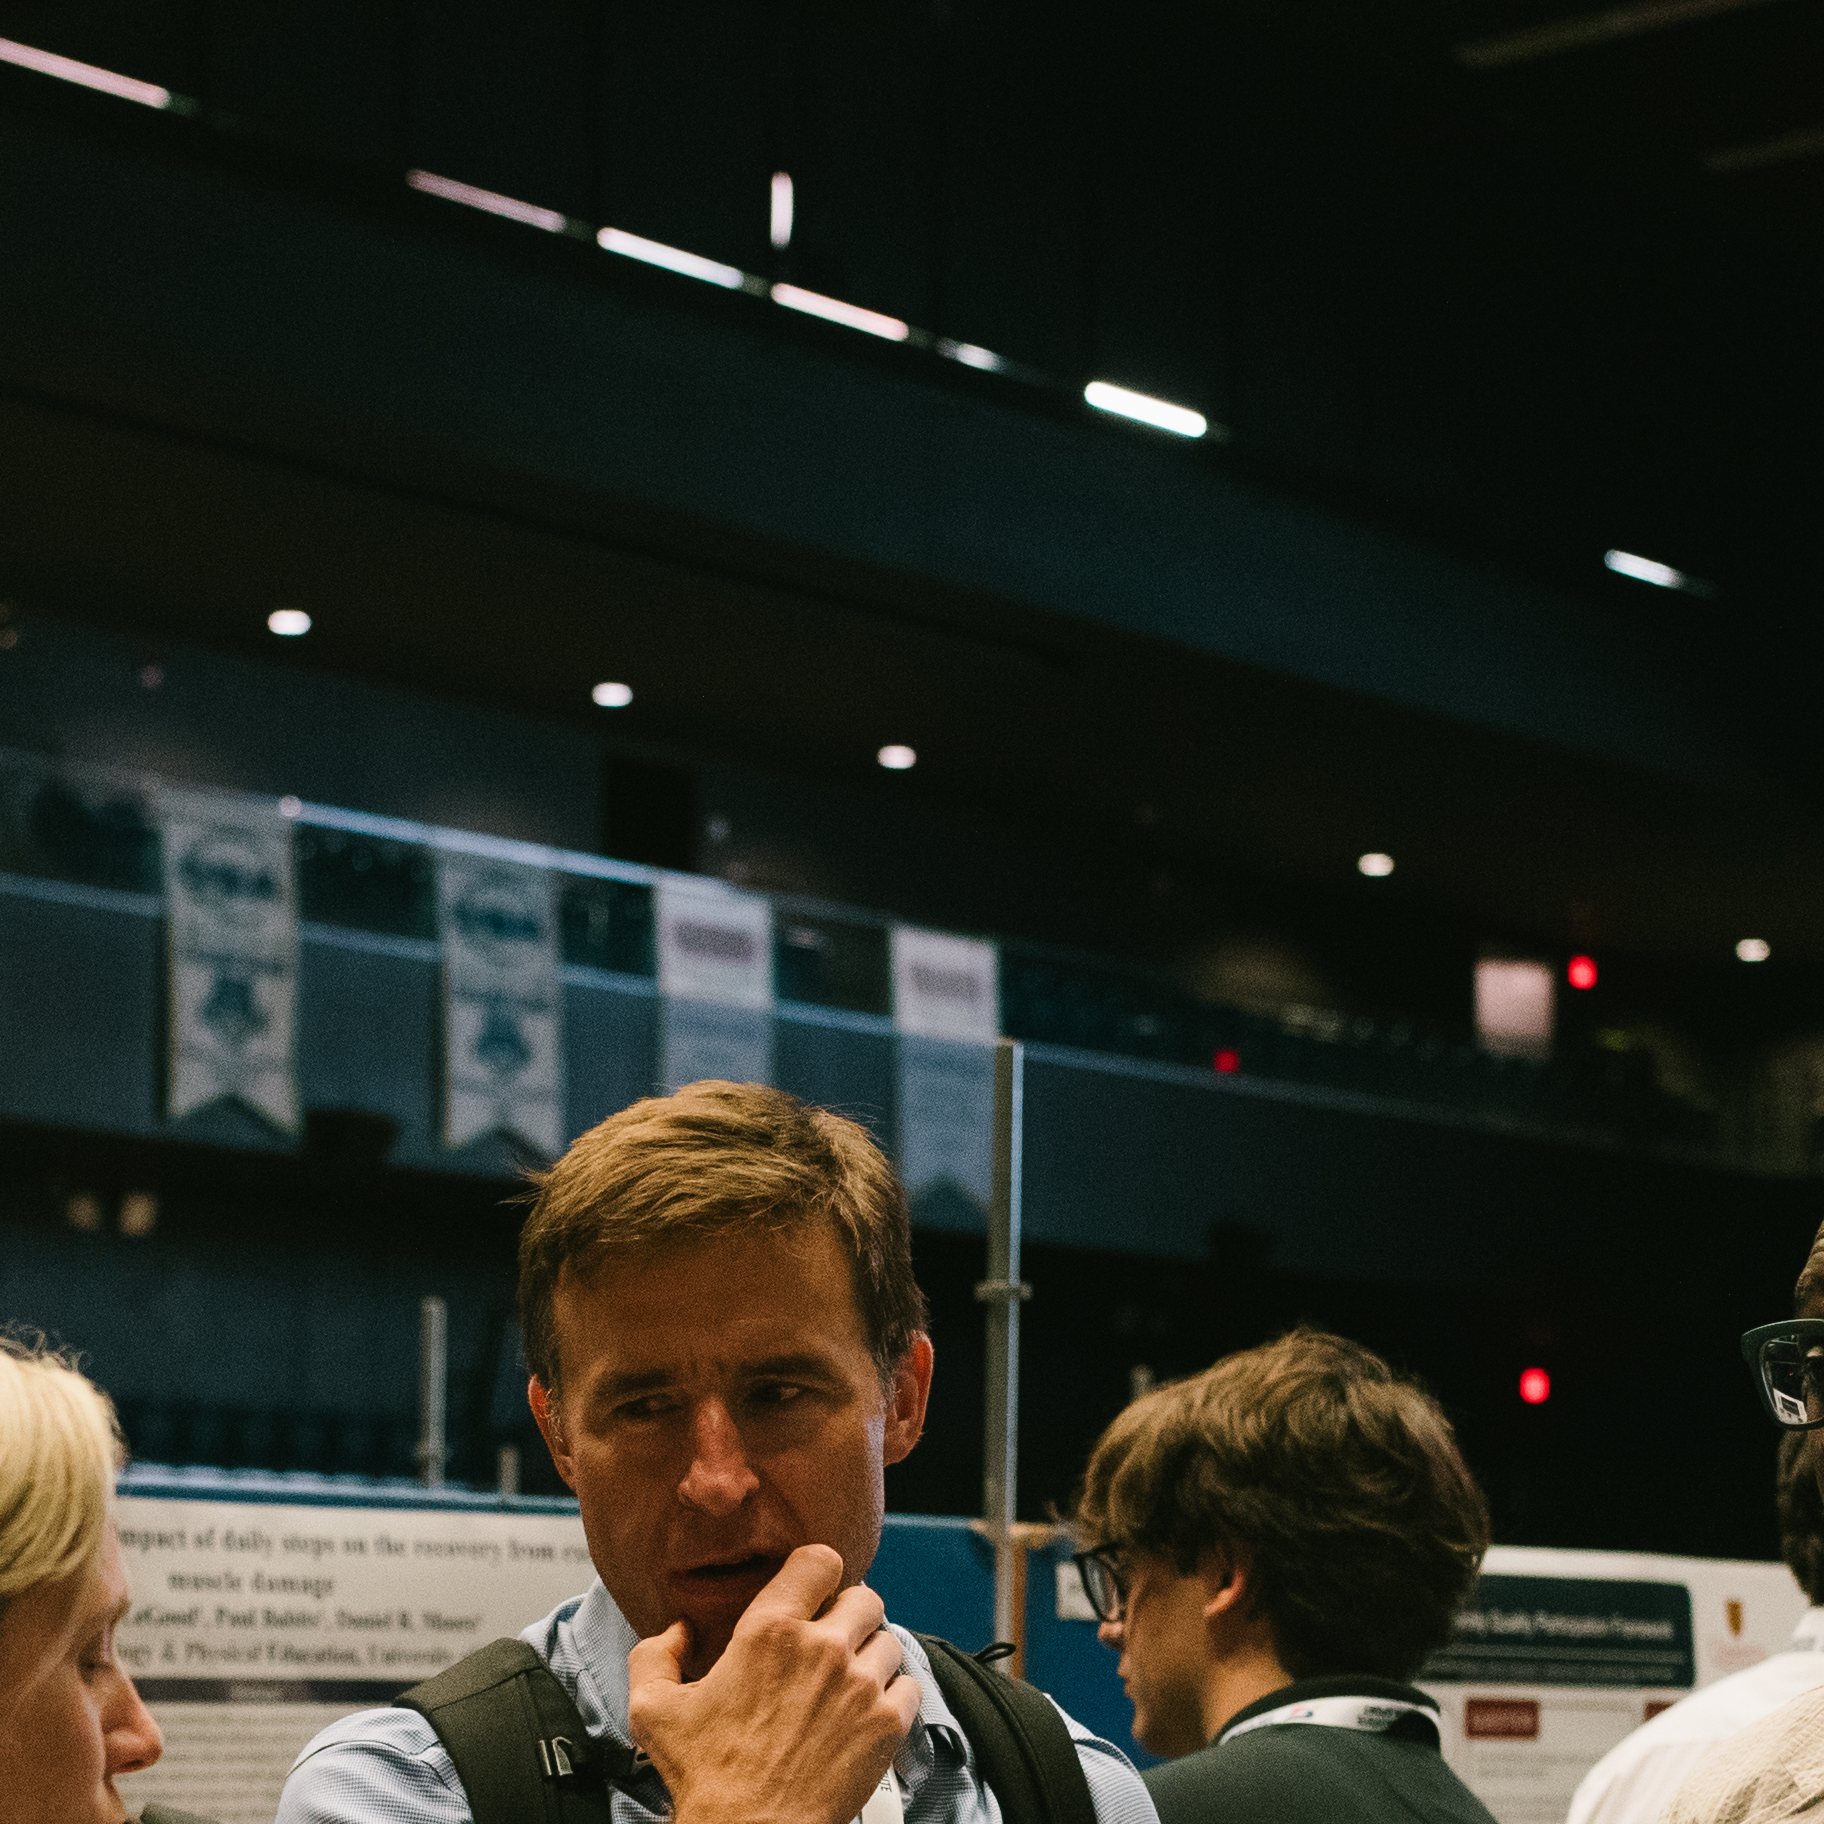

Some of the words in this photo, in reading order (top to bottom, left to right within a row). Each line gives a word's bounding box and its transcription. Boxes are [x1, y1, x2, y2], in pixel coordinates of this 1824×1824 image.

[117, 1528, 187, 1554] mpact
[222, 1528, 273, 1557] daily
[281, 1533, 335, 1560] steps
[374, 1535, 405, 1558] the
[412, 1539, 501, 1568] recovery
[508, 1538, 554, 1561] from
[167, 1570, 241, 1593] muscle
[251, 1571, 334, 1600] damage
